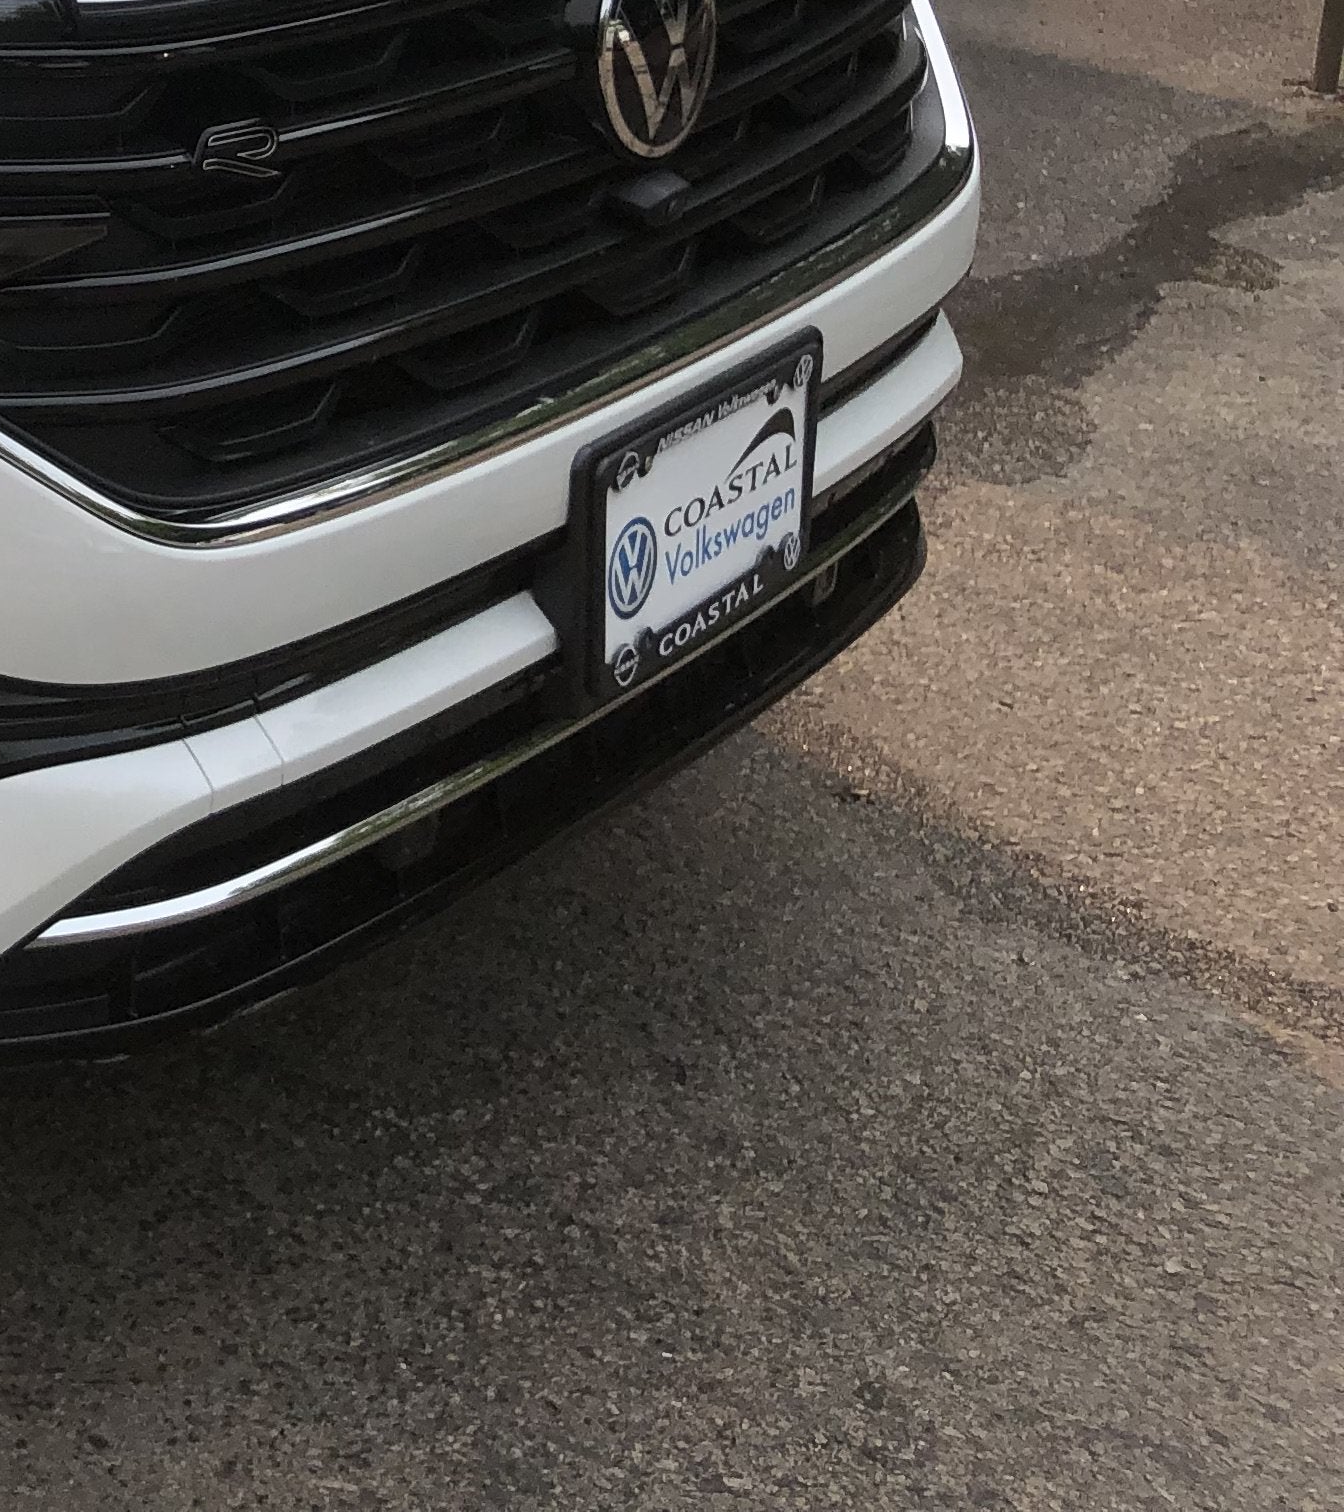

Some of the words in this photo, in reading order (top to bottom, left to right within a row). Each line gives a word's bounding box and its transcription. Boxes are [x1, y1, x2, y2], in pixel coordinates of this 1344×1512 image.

[664, 442, 797, 537] COASTAL
[664, 487, 795, 585] Volkswagen
[658, 573, 765, 656] COASTAL
